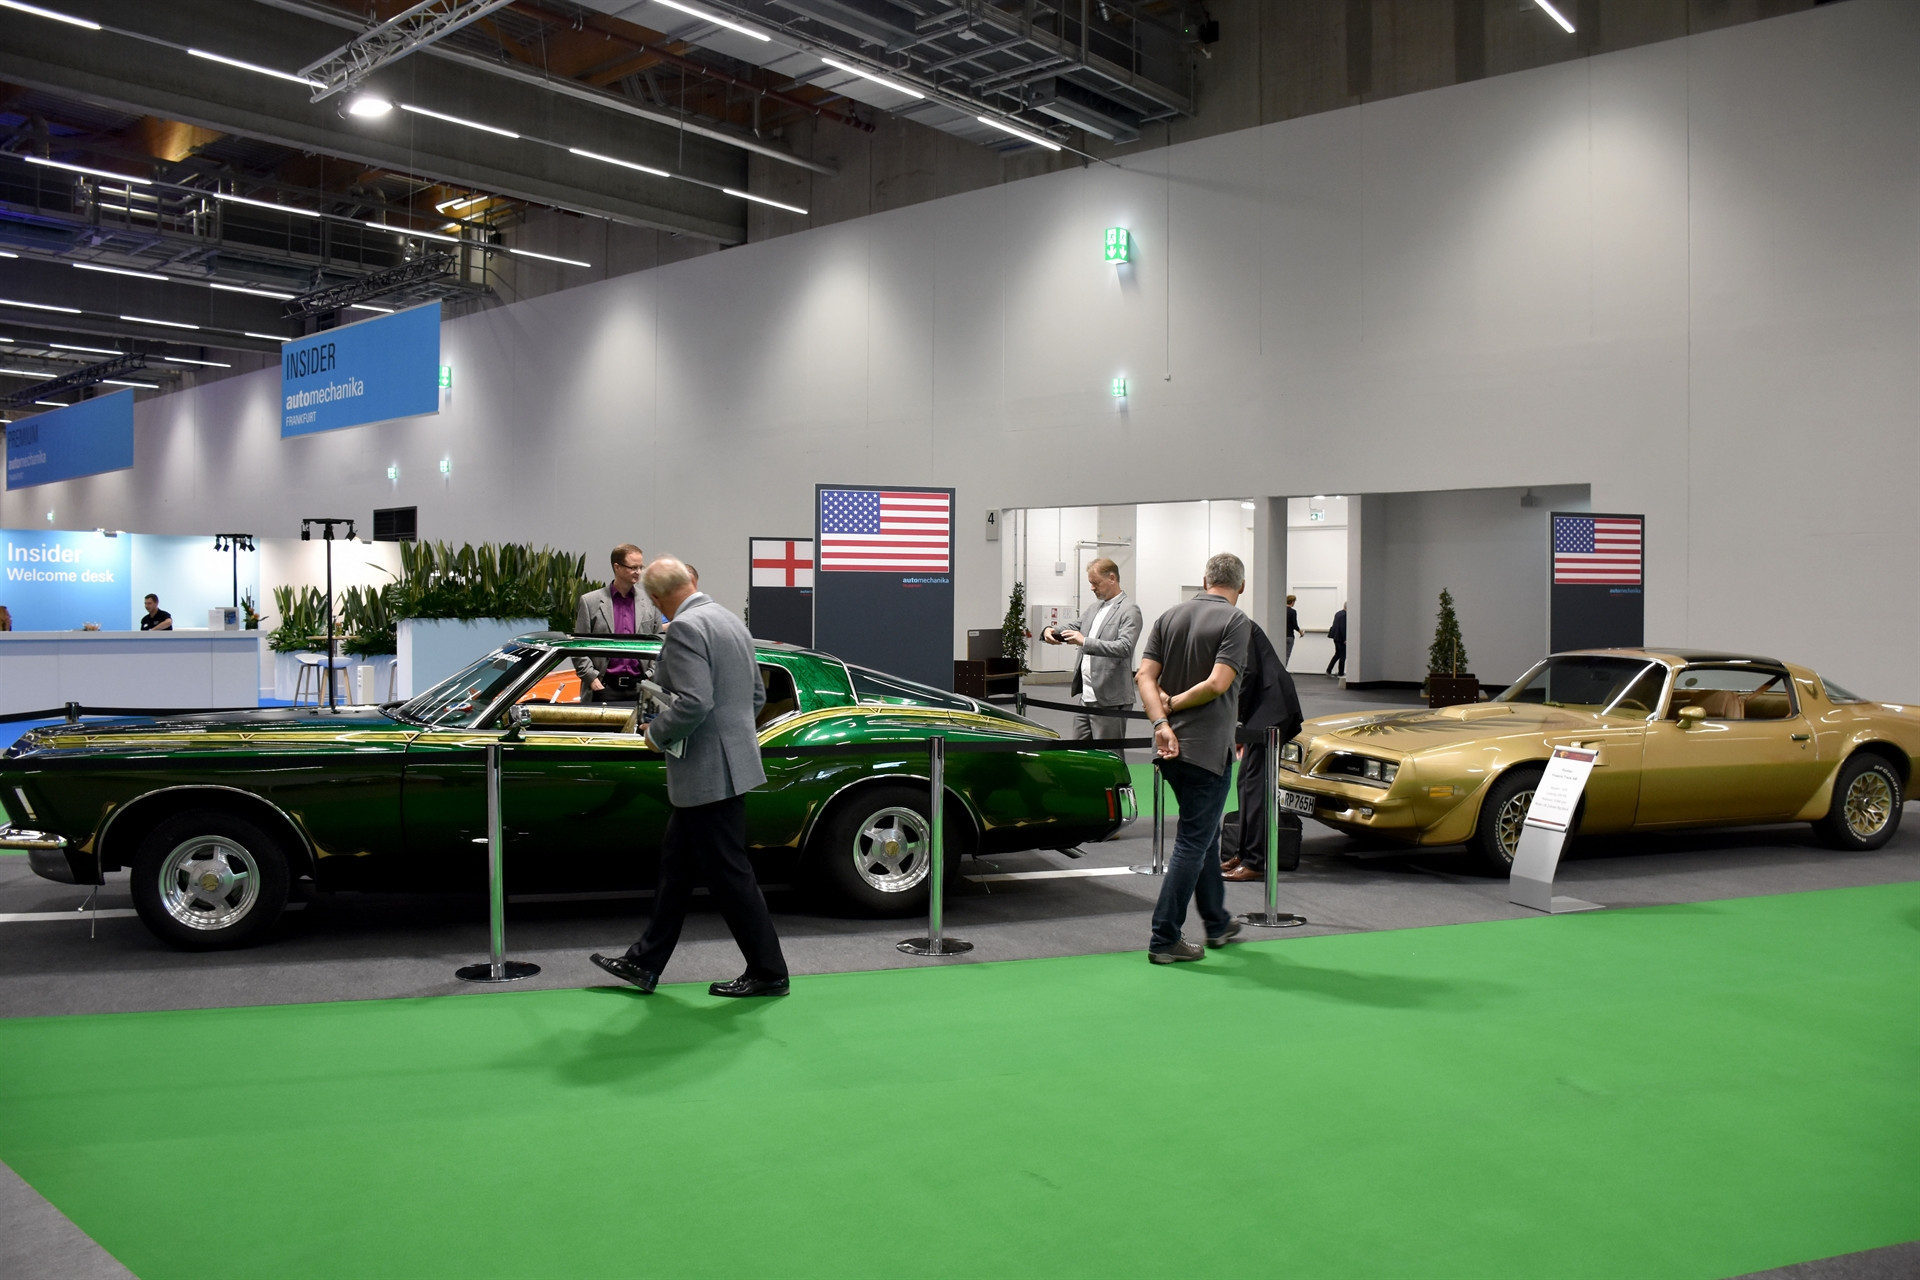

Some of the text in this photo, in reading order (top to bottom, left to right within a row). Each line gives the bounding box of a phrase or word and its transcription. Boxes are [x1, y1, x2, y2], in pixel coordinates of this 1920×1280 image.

[286, 342, 336, 380] INSIDER
[286, 376, 364, 410] automechanika
[285, 411, 317, 427] FRANKFURT
[987, 512, 995, 525] 4
[7, 542, 83, 563] Insider
[7, 567, 115, 583] Welcome desk
[902, 576, 949, 584] automechanika
[1284, 792, 1294, 807] RP
[1294, 795, 1315, 812] 765H
